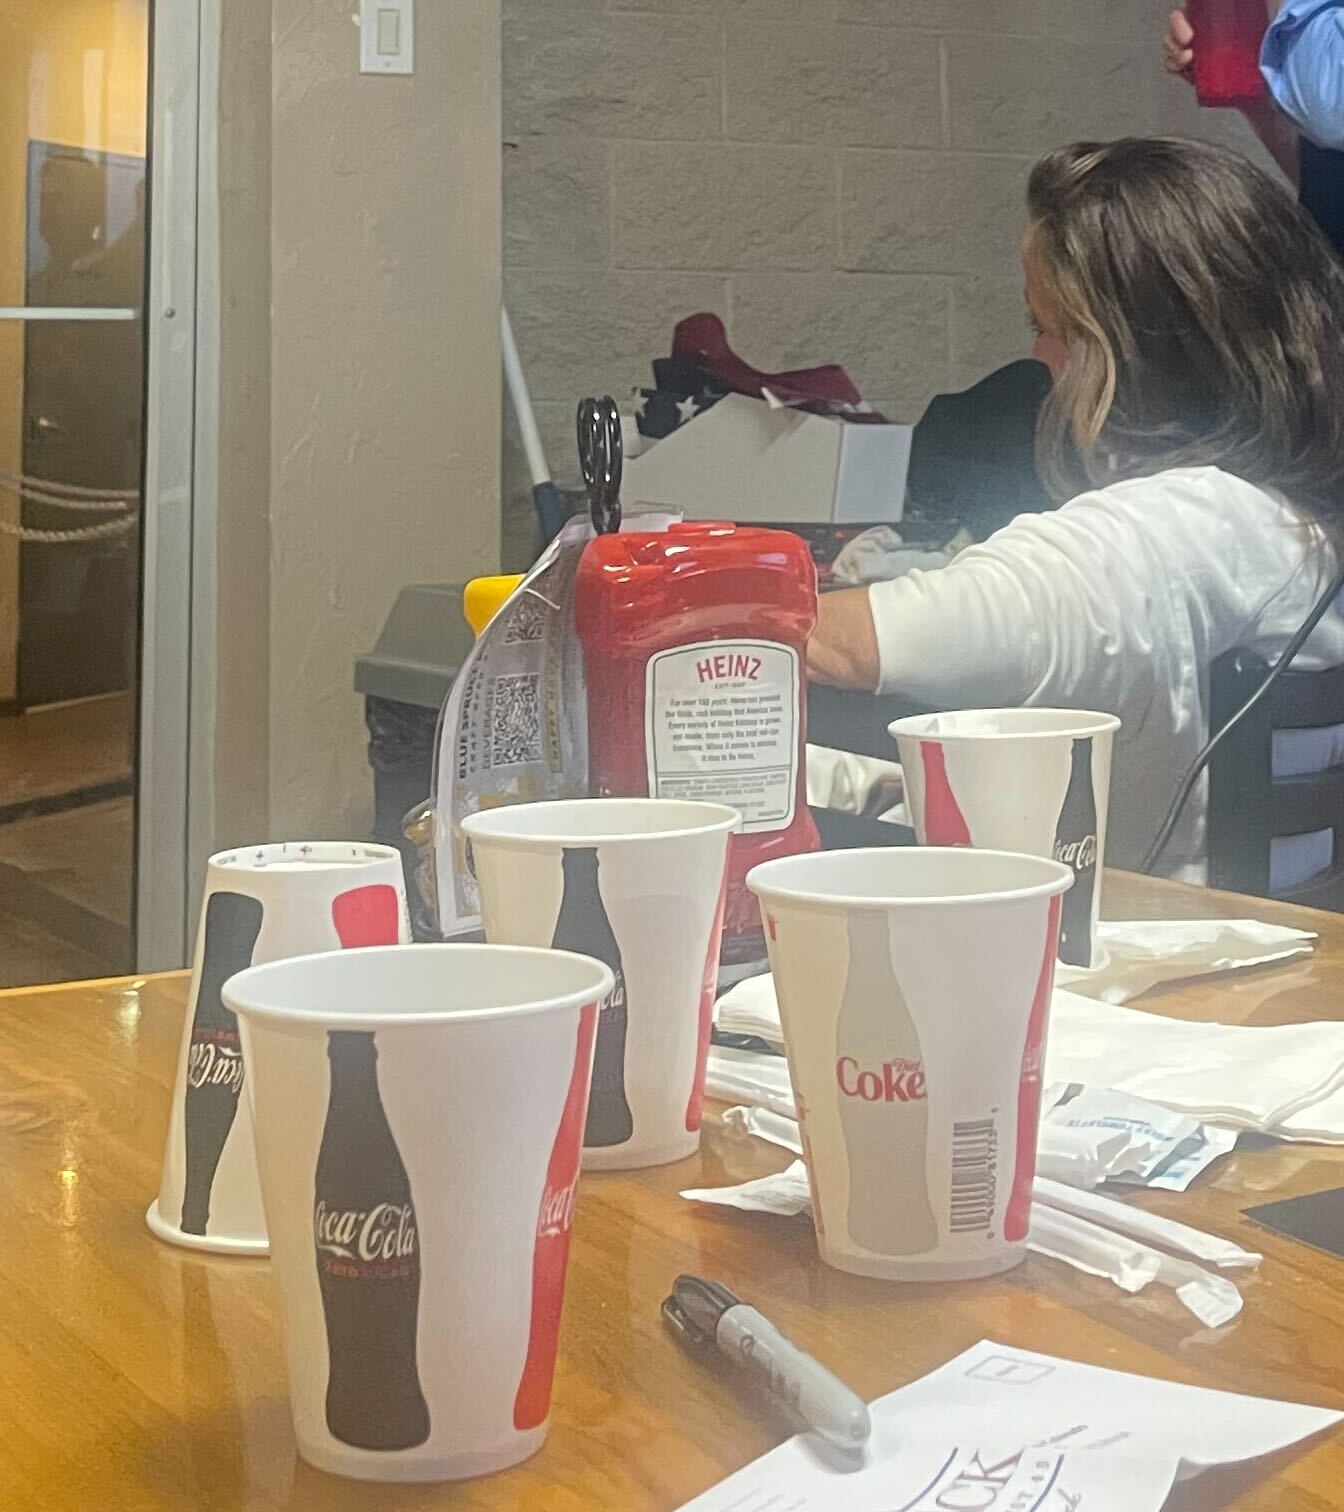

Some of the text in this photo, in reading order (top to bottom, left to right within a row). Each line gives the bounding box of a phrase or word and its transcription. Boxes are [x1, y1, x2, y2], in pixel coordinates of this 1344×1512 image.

[696, 654, 762, 683] HEINZ
[458, 735, 469, 779] BLUE
[836, 1056, 928, 1102] Coke
